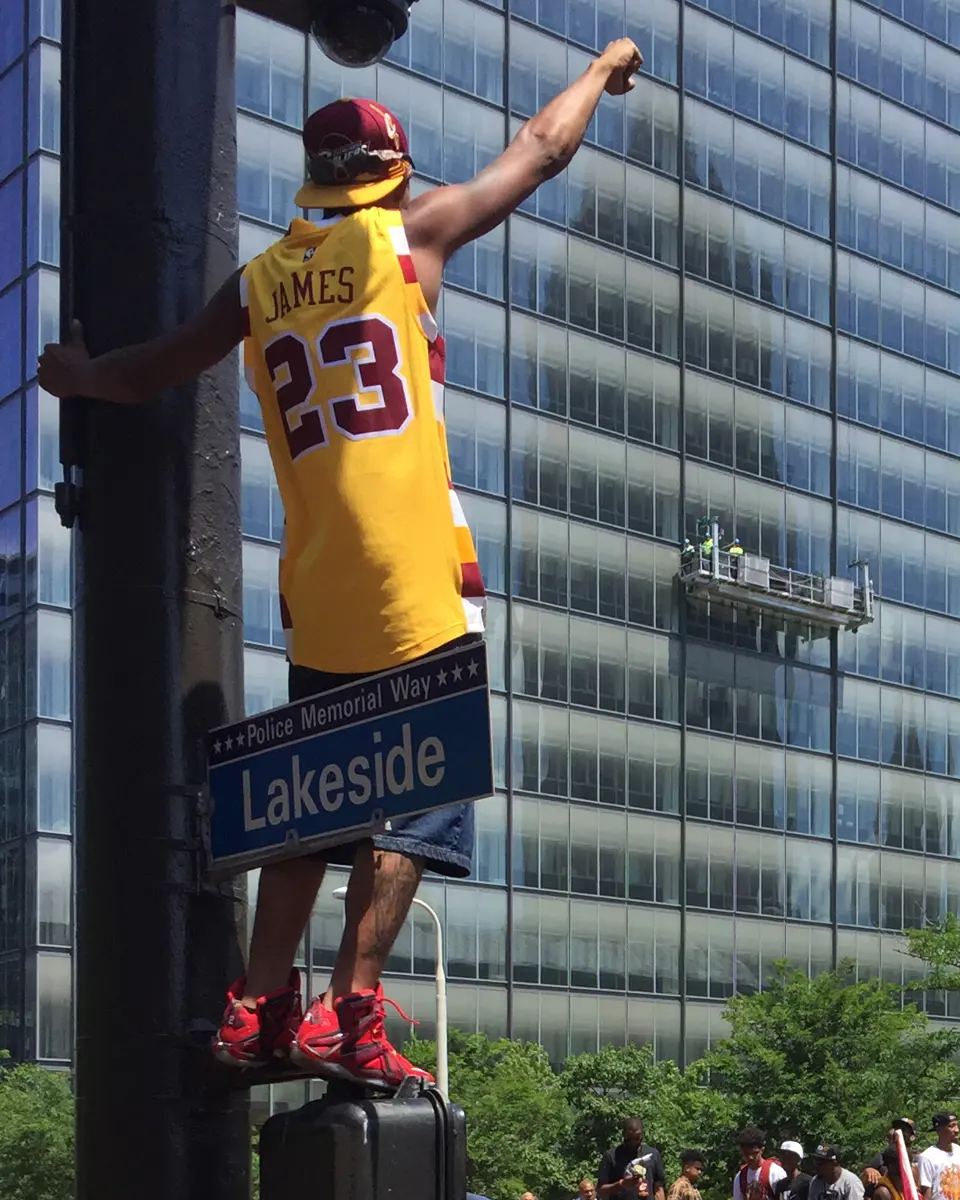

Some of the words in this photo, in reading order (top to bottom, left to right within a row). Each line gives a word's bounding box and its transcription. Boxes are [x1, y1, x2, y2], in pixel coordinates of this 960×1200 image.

[265, 266, 355, 324] JAMES
[264, 312, 414, 464] 23
[247, 717, 294, 747] Police
[301, 683, 383, 730] Memorial
[390, 674, 431, 702] Way
[242, 722, 446, 832] Lakeside
